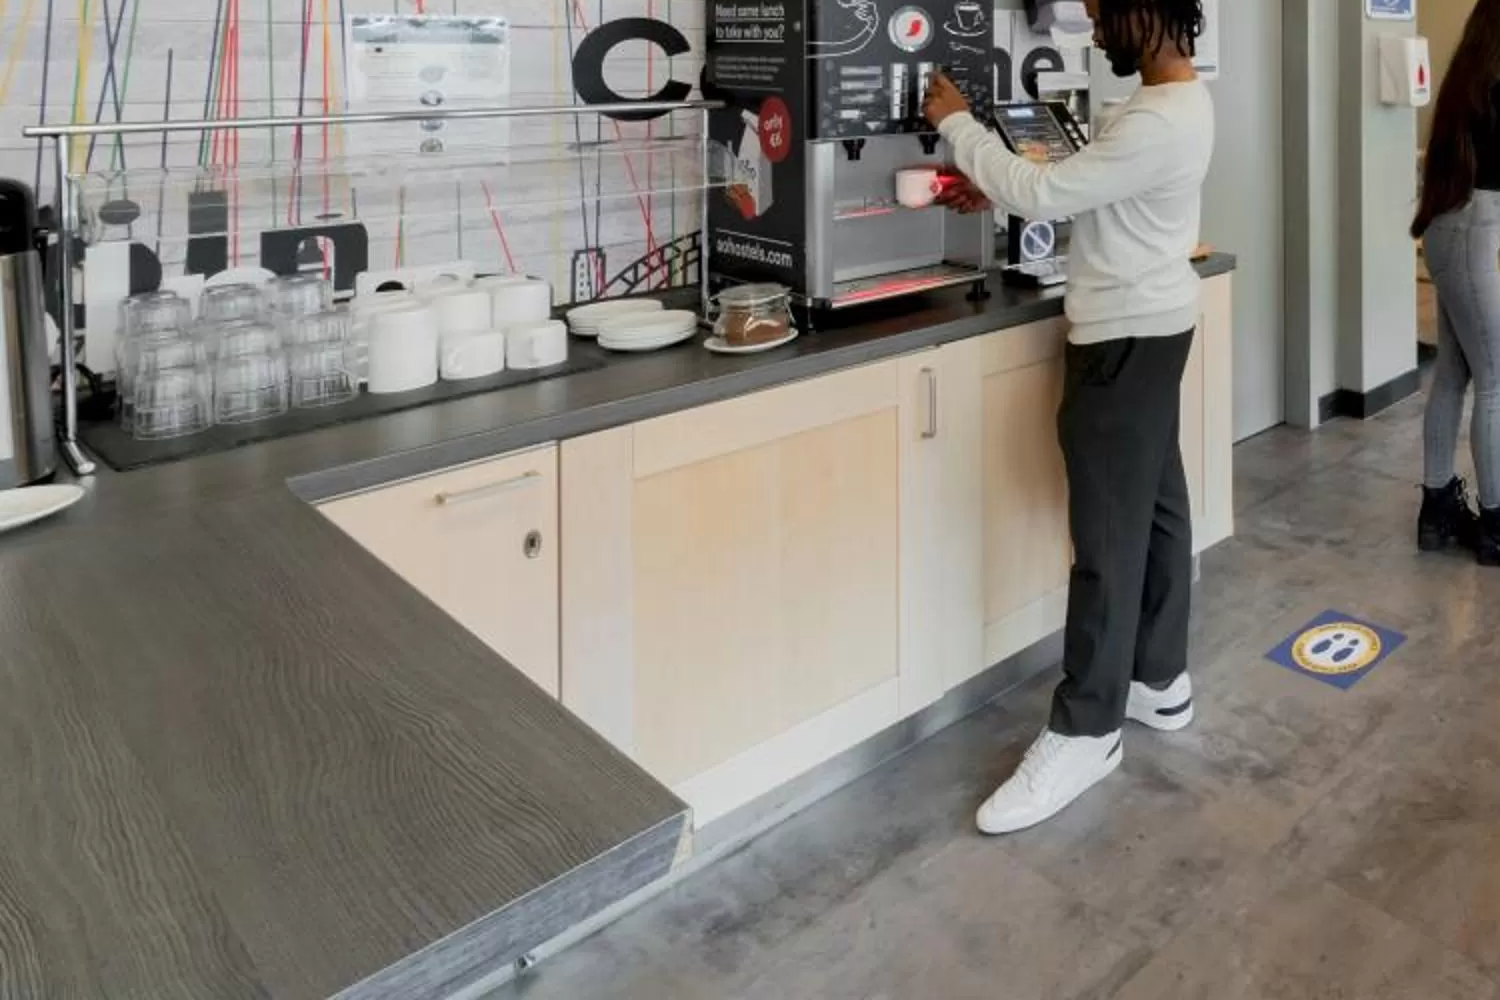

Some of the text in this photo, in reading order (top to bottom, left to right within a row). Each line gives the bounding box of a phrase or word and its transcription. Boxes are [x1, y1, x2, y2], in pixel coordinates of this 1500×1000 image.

[715, 1, 785, 18] Need some lunch
[715, 23, 785, 41] to take with you?
